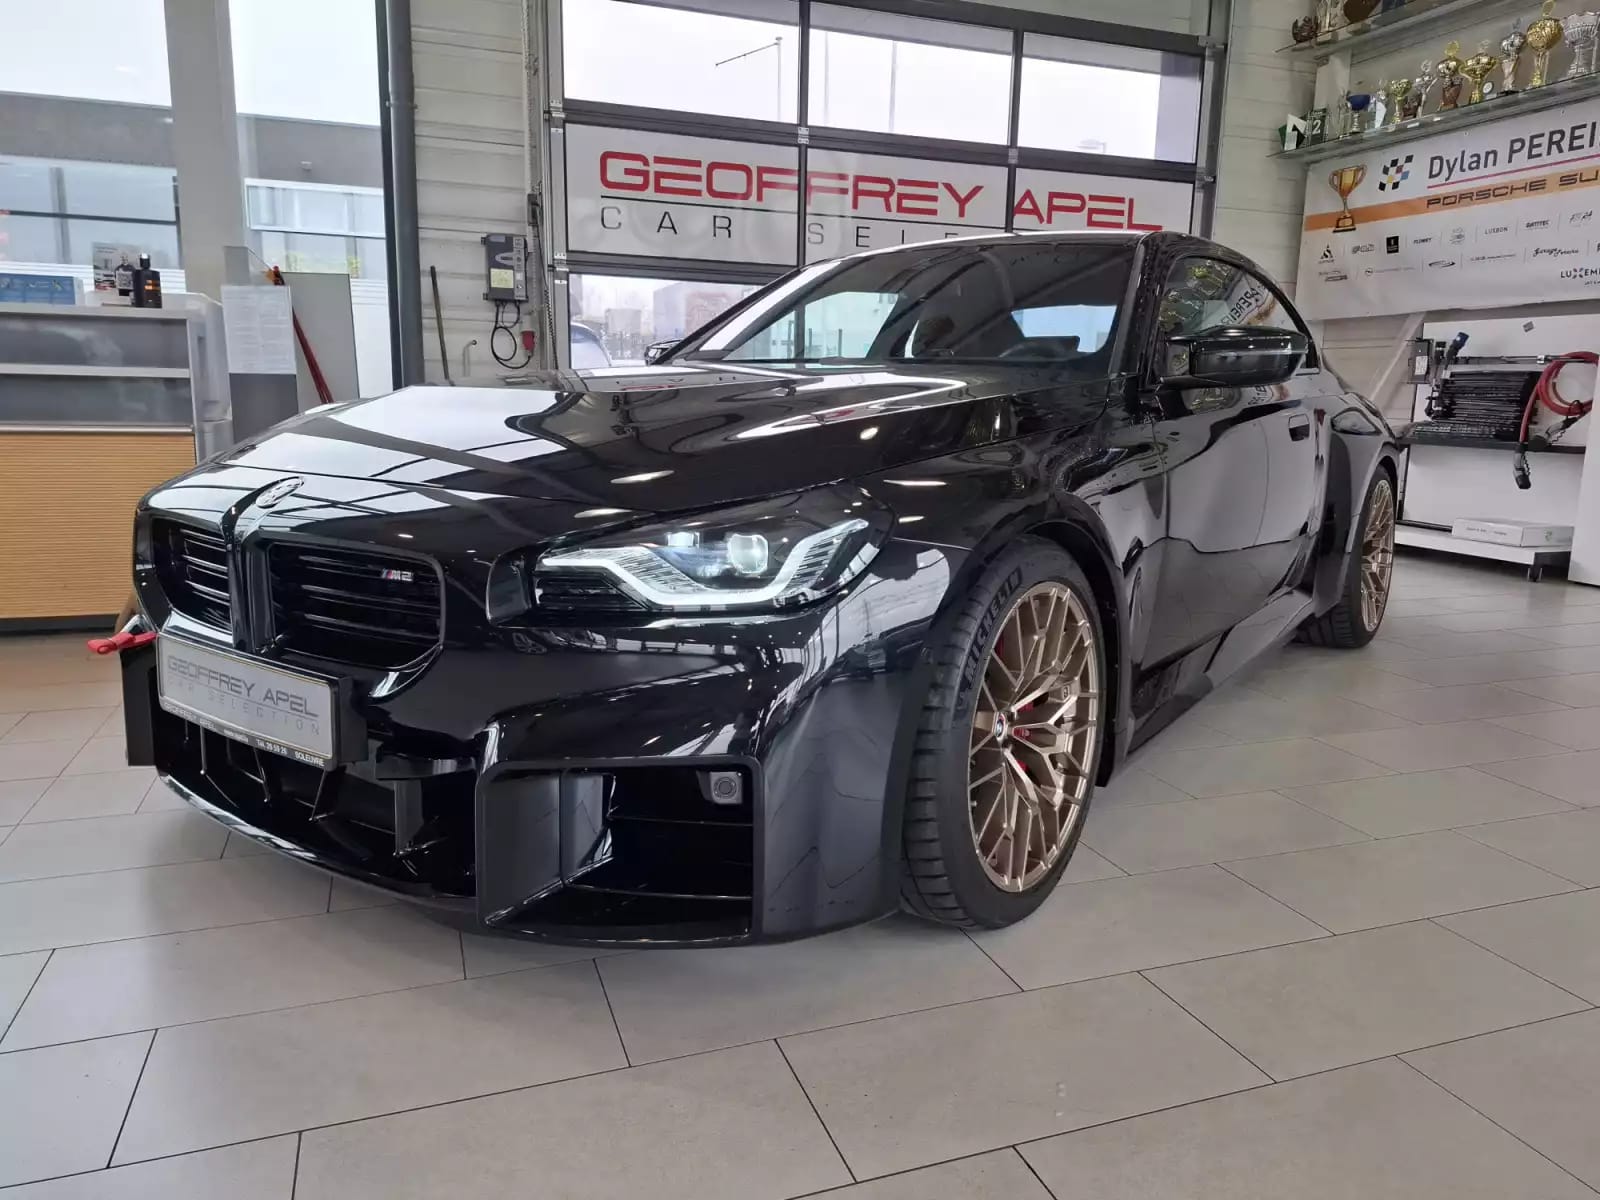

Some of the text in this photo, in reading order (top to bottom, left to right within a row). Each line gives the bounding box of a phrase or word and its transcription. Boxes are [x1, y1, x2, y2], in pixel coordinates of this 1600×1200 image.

[1428, 121, 1600, 182] Dylan PEREI
[599, 150, 1163, 231] GEOFFREY APEL
[1426, 178, 1547, 209] PORSCHE
[601, 206, 733, 239] CAR
[167, 656, 320, 718] GEOFFREY APEL
